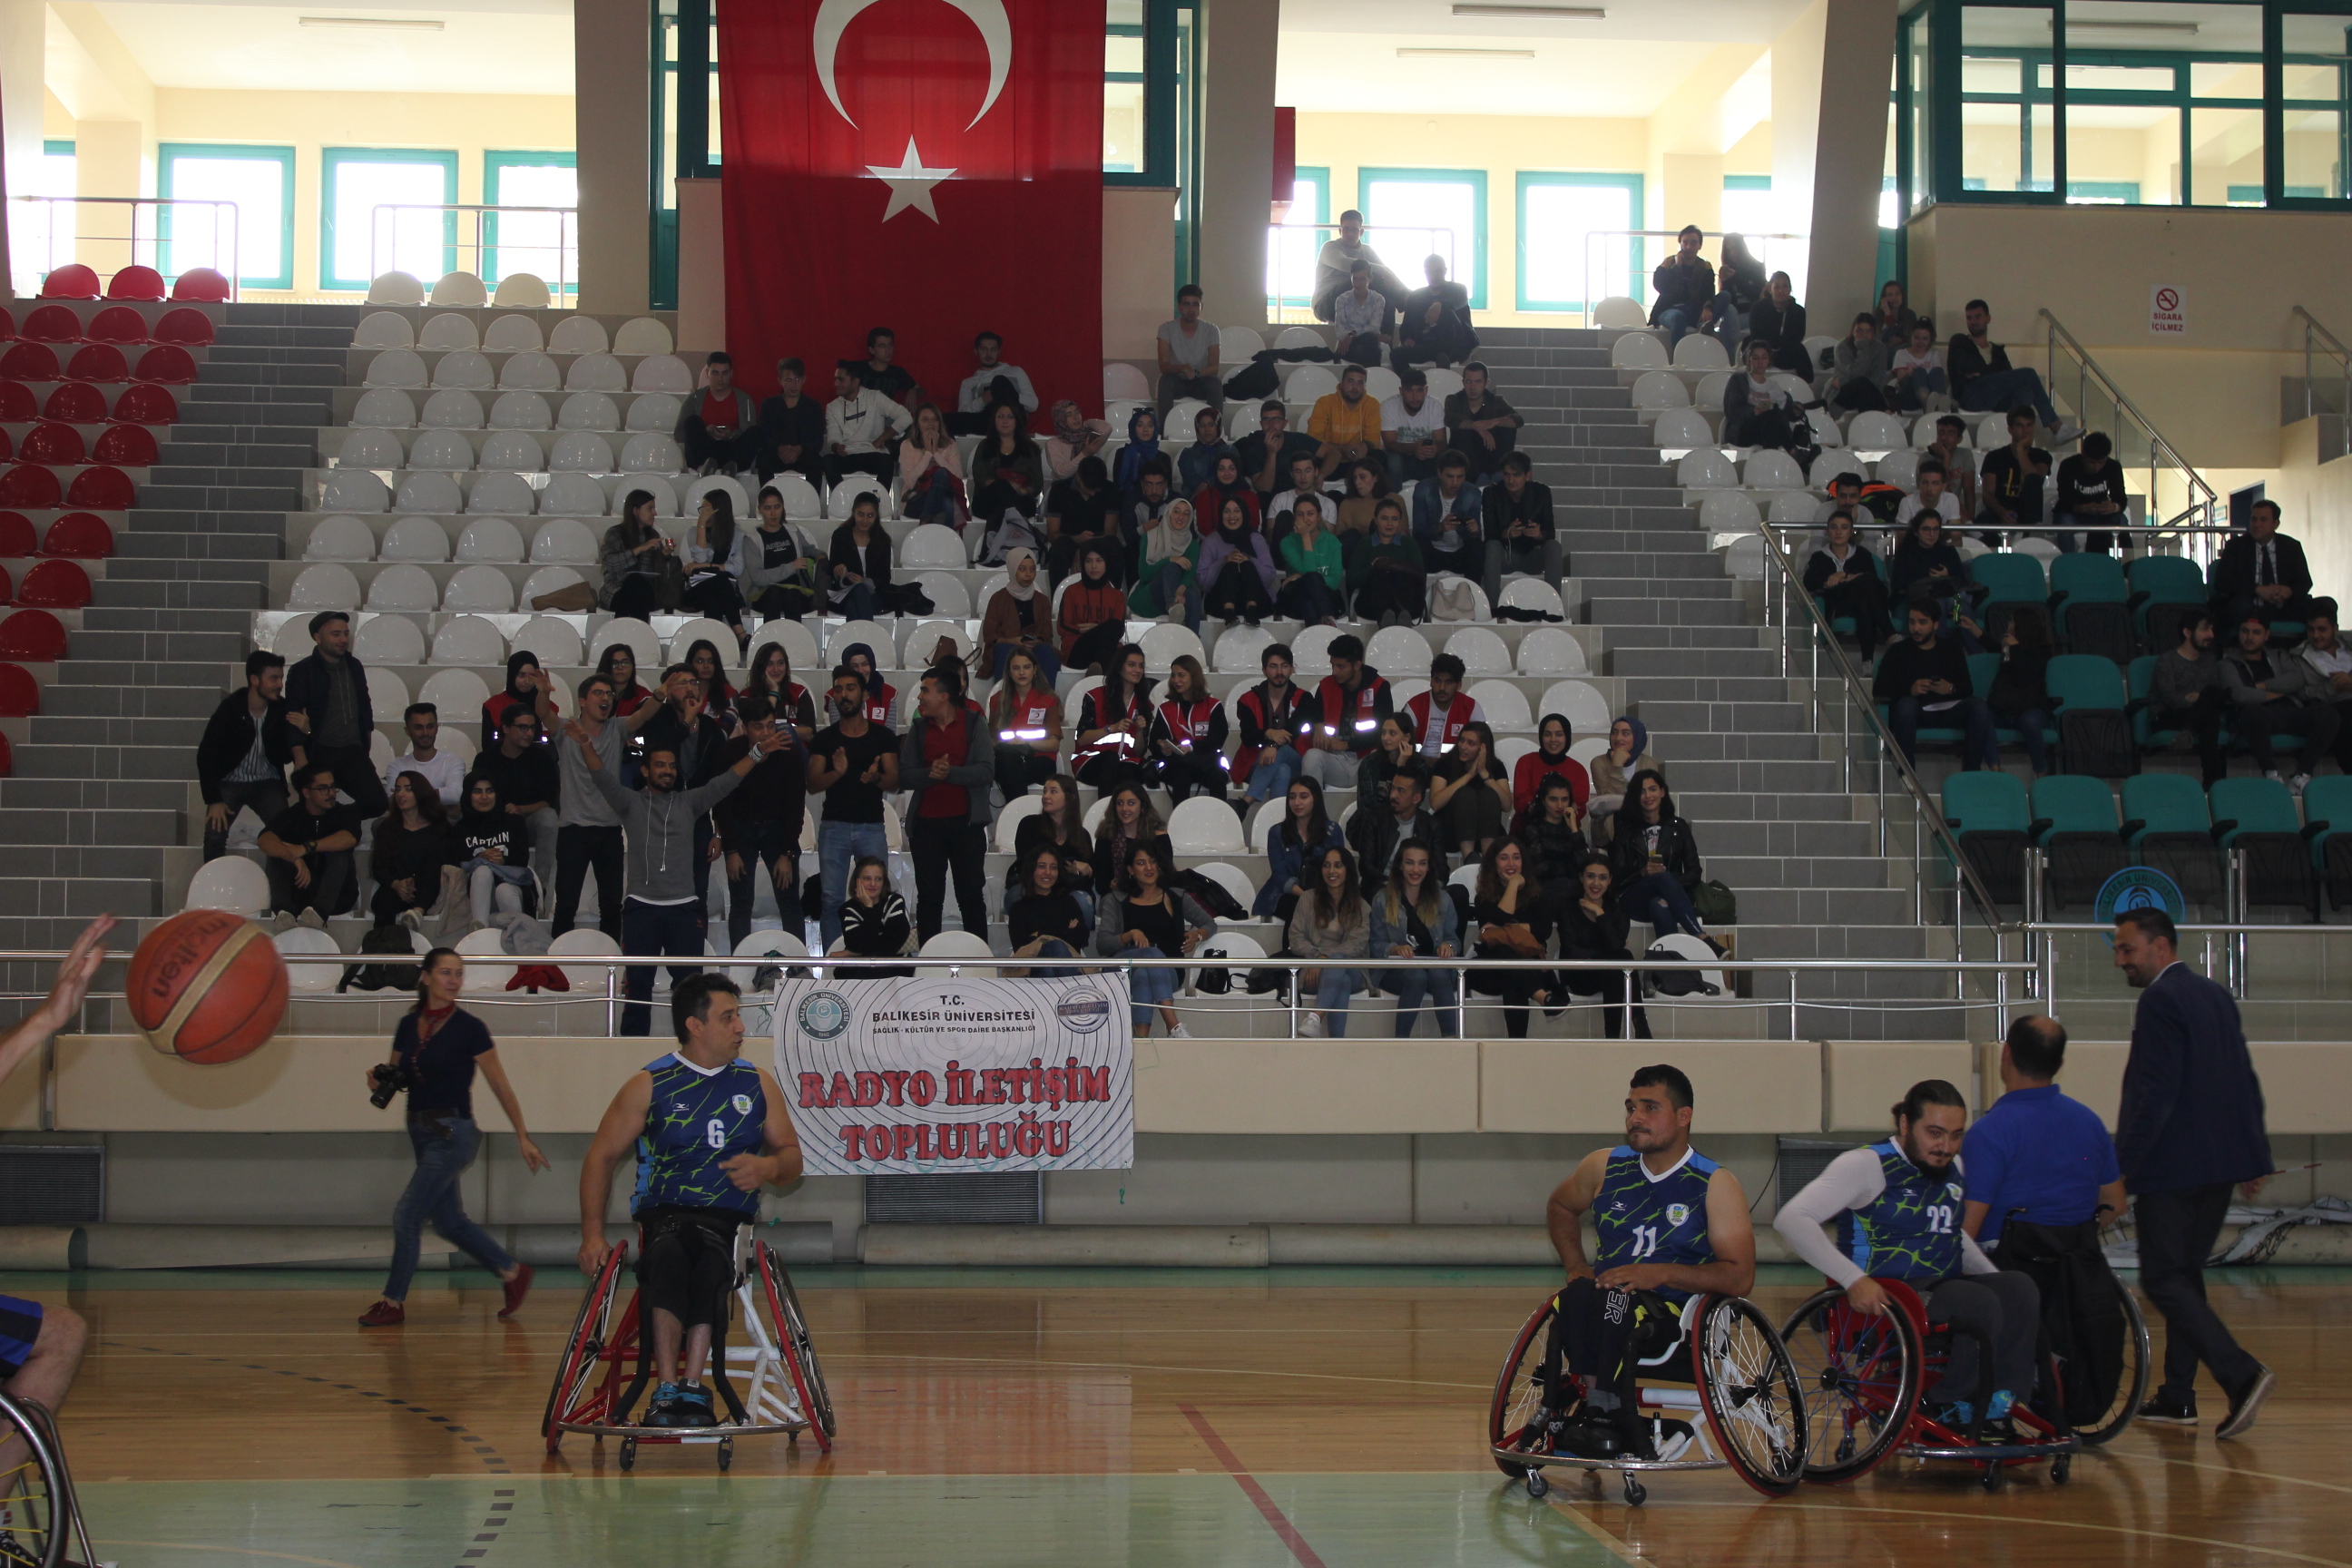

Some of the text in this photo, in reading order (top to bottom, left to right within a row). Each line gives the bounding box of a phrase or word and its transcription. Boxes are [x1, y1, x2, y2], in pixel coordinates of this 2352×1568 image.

[2151, 321, 2184, 332] İÇİLMEZ
[2153, 311, 2183, 321] SİGARA
[466, 831, 510, 848] CAPTAIN
[152, 916, 229, 998] molten
[940, 995, 965, 1005] T.C.
[872, 1008, 1035, 1023] BALIKESİR ÜNİVERSİTESİ
[873, 1025, 899, 1034] SAĞLIK
[905, 1025, 934, 1034] KÜLTÜR
[967, 1025, 989, 1034] DAİRE
[992, 1024, 1035, 1034] BAŞKANLIĞI
[798, 1056, 1111, 1112] RADYO İLETİŞİM
[707, 1118, 726, 1149] 6
[838, 1109, 1072, 1161] TOPLULUĞU
[1926, 1205, 1954, 1234] 22
[1631, 1224, 1658, 1258] 11
